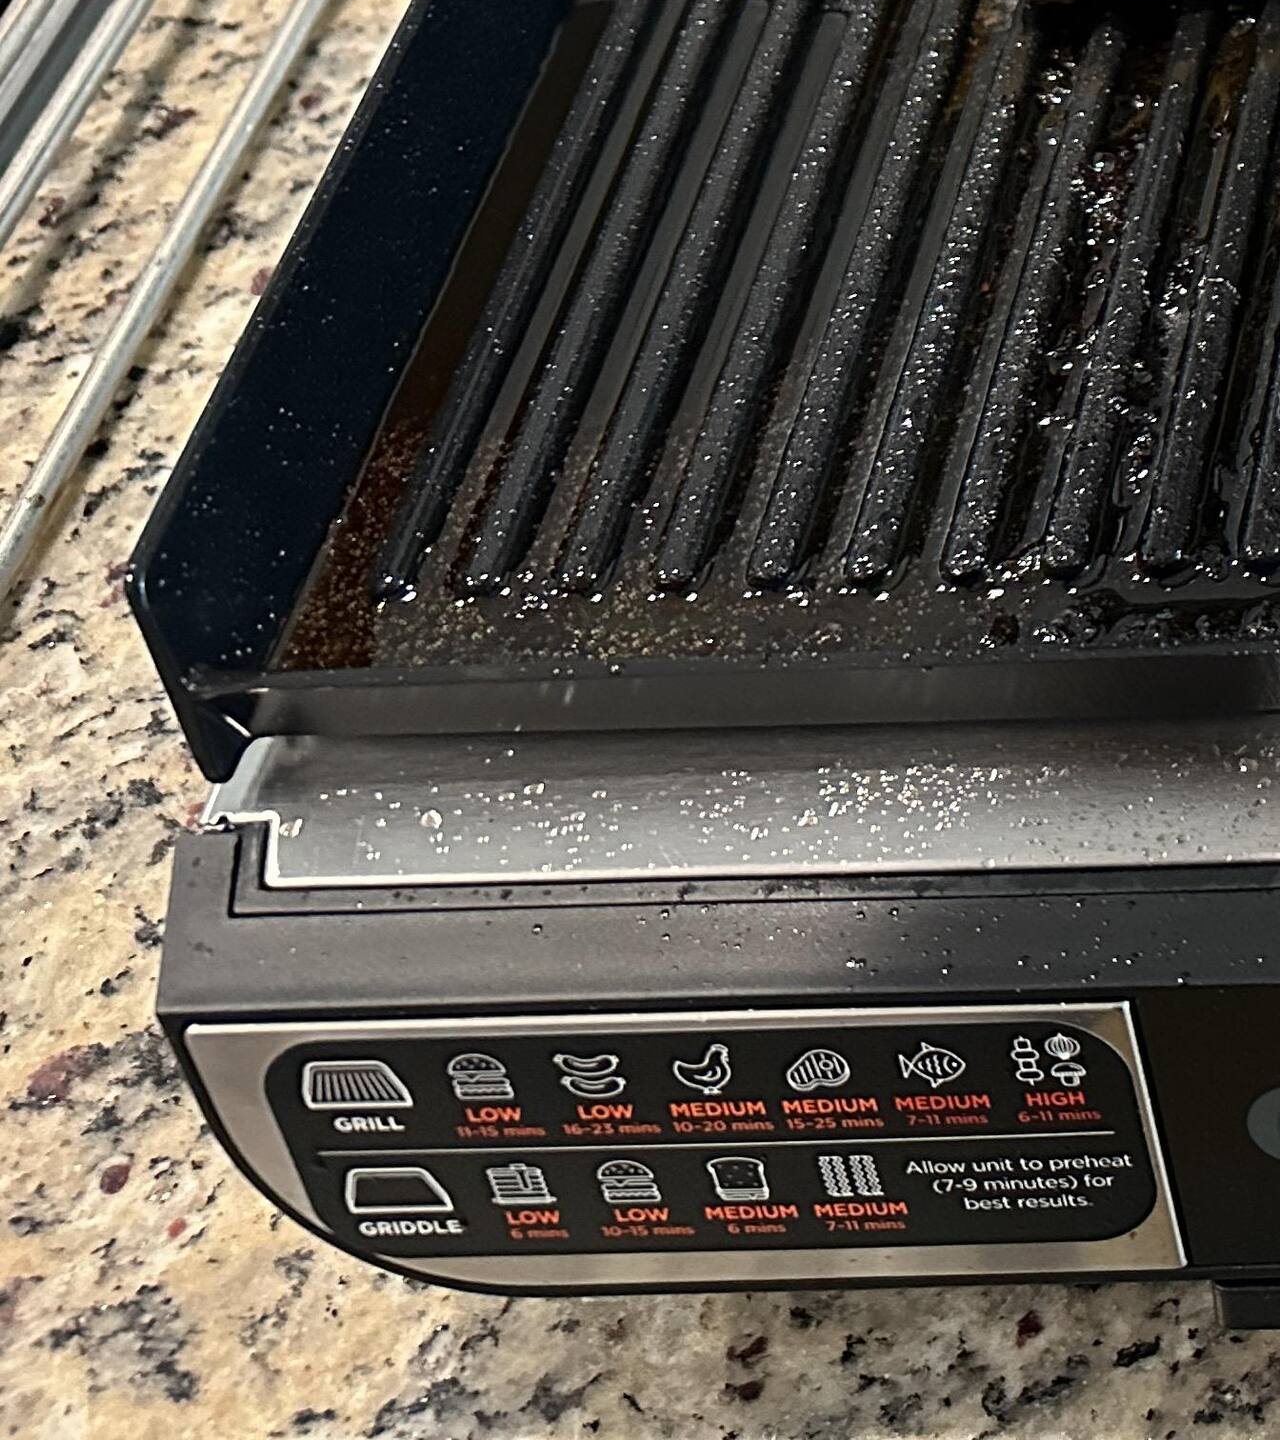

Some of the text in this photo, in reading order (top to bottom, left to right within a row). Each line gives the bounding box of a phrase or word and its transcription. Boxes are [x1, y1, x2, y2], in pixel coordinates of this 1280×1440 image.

[781, 1097, 878, 1114] MEDIUM
[895, 1094, 991, 1111] MEDIUM
[1025, 1091, 1086, 1107] HIGH
[465, 1106, 522, 1123] LOW
[576, 1104, 634, 1121] LOW
[669, 1101, 767, 1118] MEDIUM
[1018, 1109, 1101, 1123] 6-11 mins
[333, 1116, 406, 1133] GRILL
[673, 1119, 775, 1133] 10-20 mins
[786, 1116, 885, 1130] 15-25 mins
[907, 1112, 989, 1126] 7-11 mins
[503, 1125, 546, 1137] mins
[618, 1122, 662, 1134] mins
[906, 1154, 1134, 1174] Allow unit to preheat
[932, 1174, 1115, 1194] (7-9 minutes) for
[814, 1201, 909, 1217] MEDIUM
[964, 1194, 1095, 1210] best results.
[505, 1210, 561, 1225] LOW
[614, 1207, 670, 1223] LOW
[704, 1204, 800, 1220] MEDIUM
[359, 1220, 464, 1237] GRIDDLE
[602, 1225, 696, 1237] 10-15 mins
[727, 1222, 787, 1234] 6 mins
[824, 1219, 906, 1231] 7-11 mins
[511, 1228, 570, 1239] 6 mins
